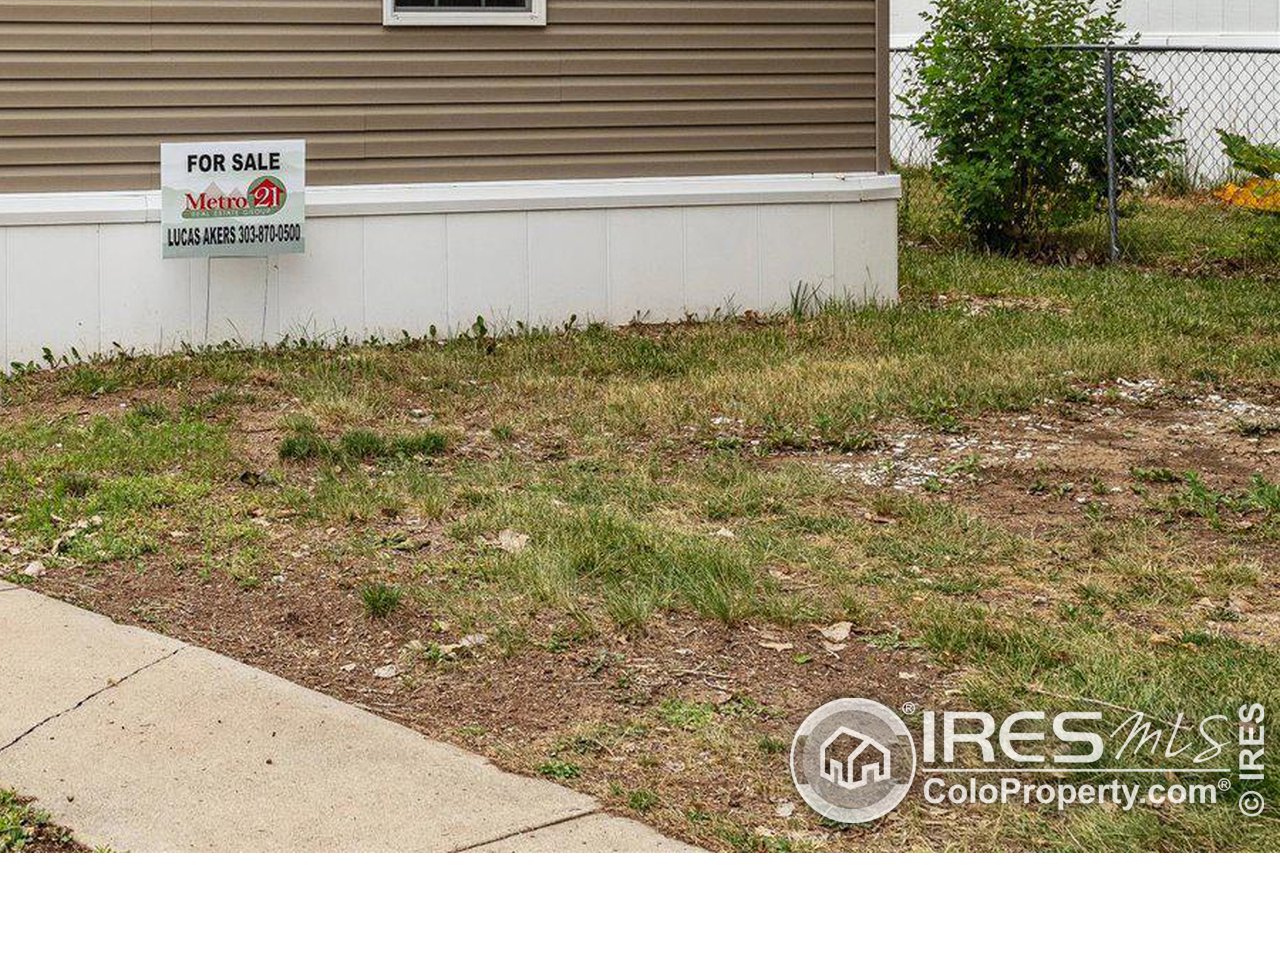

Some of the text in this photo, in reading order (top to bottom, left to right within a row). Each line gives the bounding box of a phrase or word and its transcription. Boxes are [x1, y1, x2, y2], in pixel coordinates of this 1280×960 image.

[187, 152, 280, 172] FOR SALE
[185, 187, 281, 211] Metro 21
[168, 223, 301, 246] LUCAS AKERS 303-870-0500
